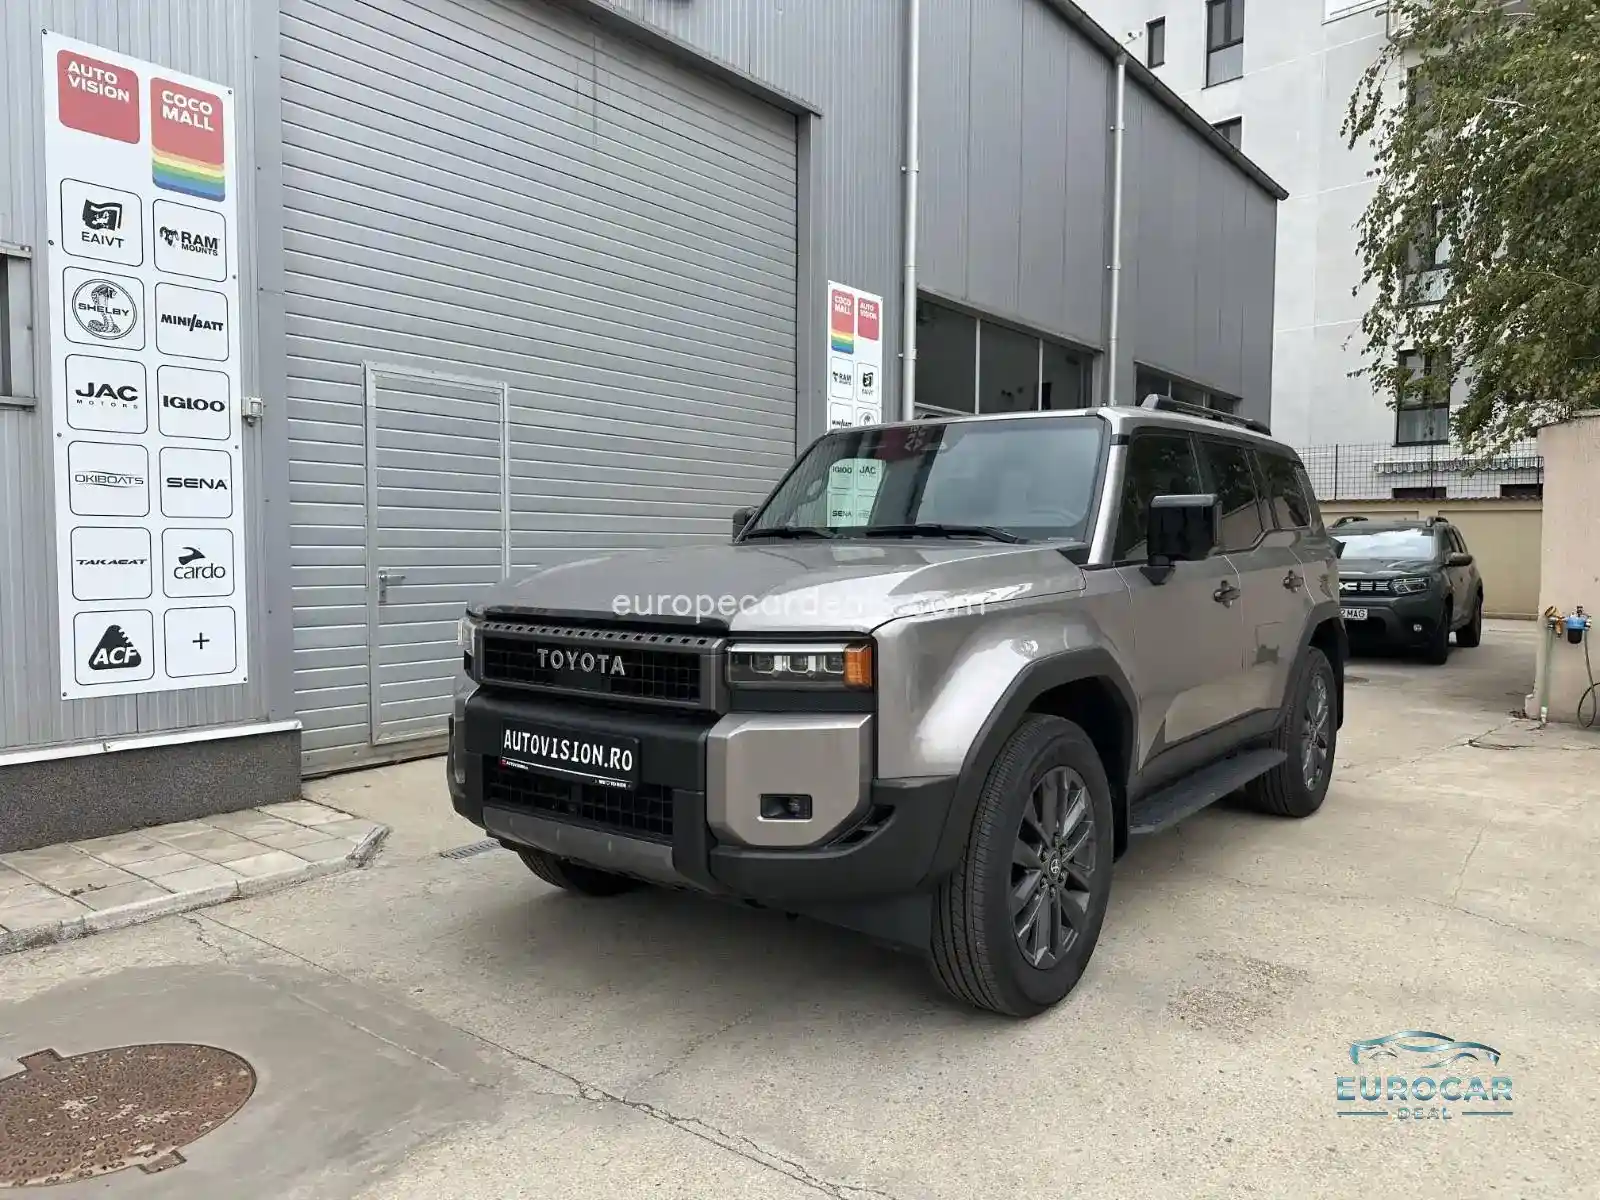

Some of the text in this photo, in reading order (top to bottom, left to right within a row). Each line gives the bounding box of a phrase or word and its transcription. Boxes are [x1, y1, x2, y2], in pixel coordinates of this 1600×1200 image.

[68, 61, 118, 84] AUTO
[68, 75, 129, 102] VISION
[162, 90, 213, 115] COCO
[162, 104, 215, 132] MALL
[82, 231, 124, 248] EAIVT
[181, 231, 218, 249] RAM
[181, 244, 218, 256] MOUNTS
[78, 303, 129, 316] SHELBY
[75, 383, 138, 401] JAC
[77, 399, 138, 409] MOTORS
[163, 396, 225, 412] IGLOO
[860, 466, 876, 474] JAC
[75, 474, 143, 485] OKIBOATS
[167, 477, 227, 490] SENA
[173, 563, 226, 580] cardo
[1347, 609, 1365, 618] MAG
[93, 646, 137, 665] ACF
[537, 648, 625, 676] TOYOTA
[504, 729, 633, 771] AUTOVISION.RO
